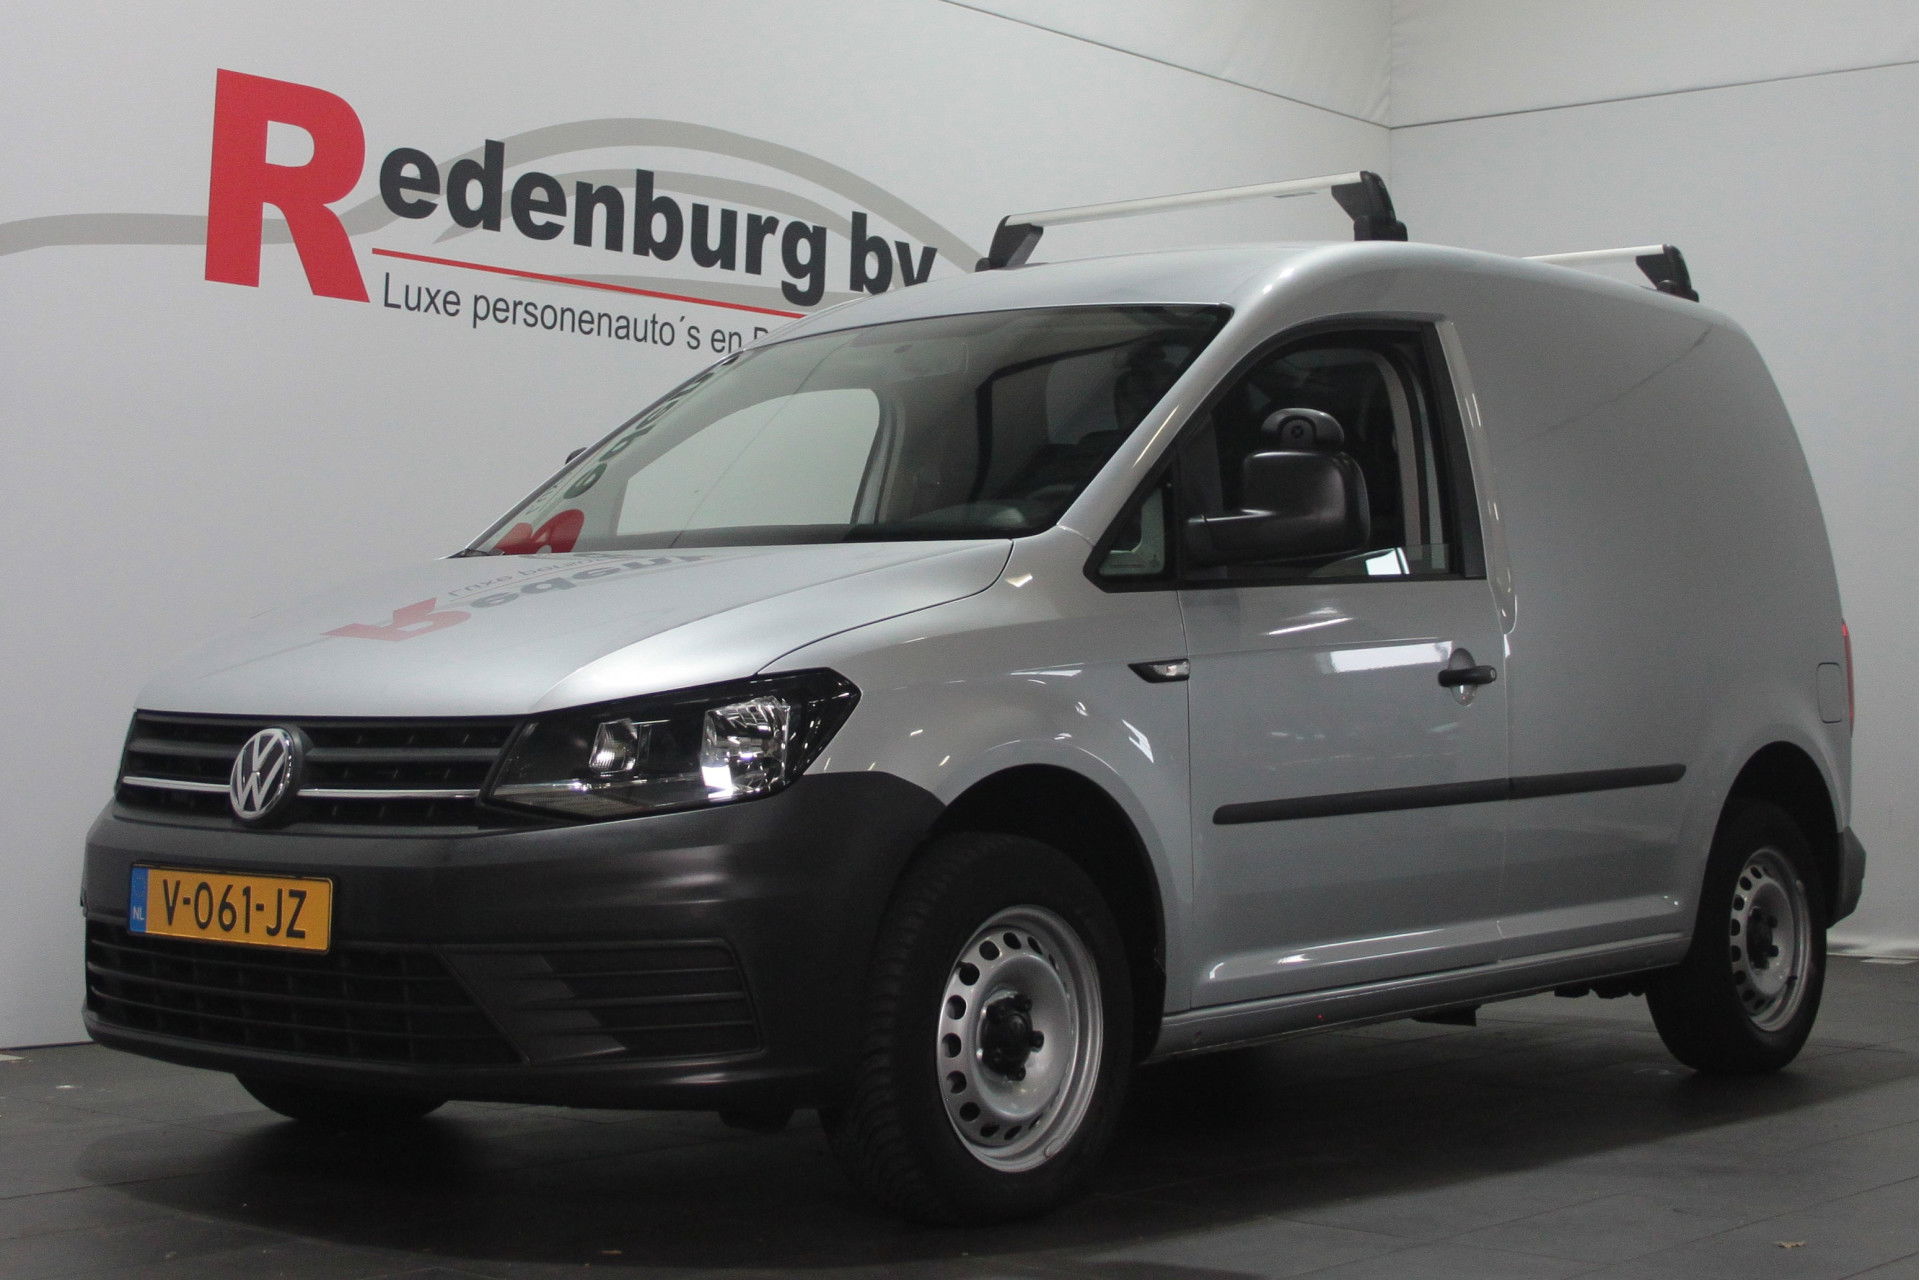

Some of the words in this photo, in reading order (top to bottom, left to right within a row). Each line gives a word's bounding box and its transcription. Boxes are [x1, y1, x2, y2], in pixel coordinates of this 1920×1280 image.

[205, 69, 827, 306] Redenburg
[849, 210, 938, 295] bv
[384, 271, 461, 316] Luxe
[710, 328, 742, 354] en
[132, 906, 145, 921] NL
[162, 879, 307, 939] V-061-JZ
